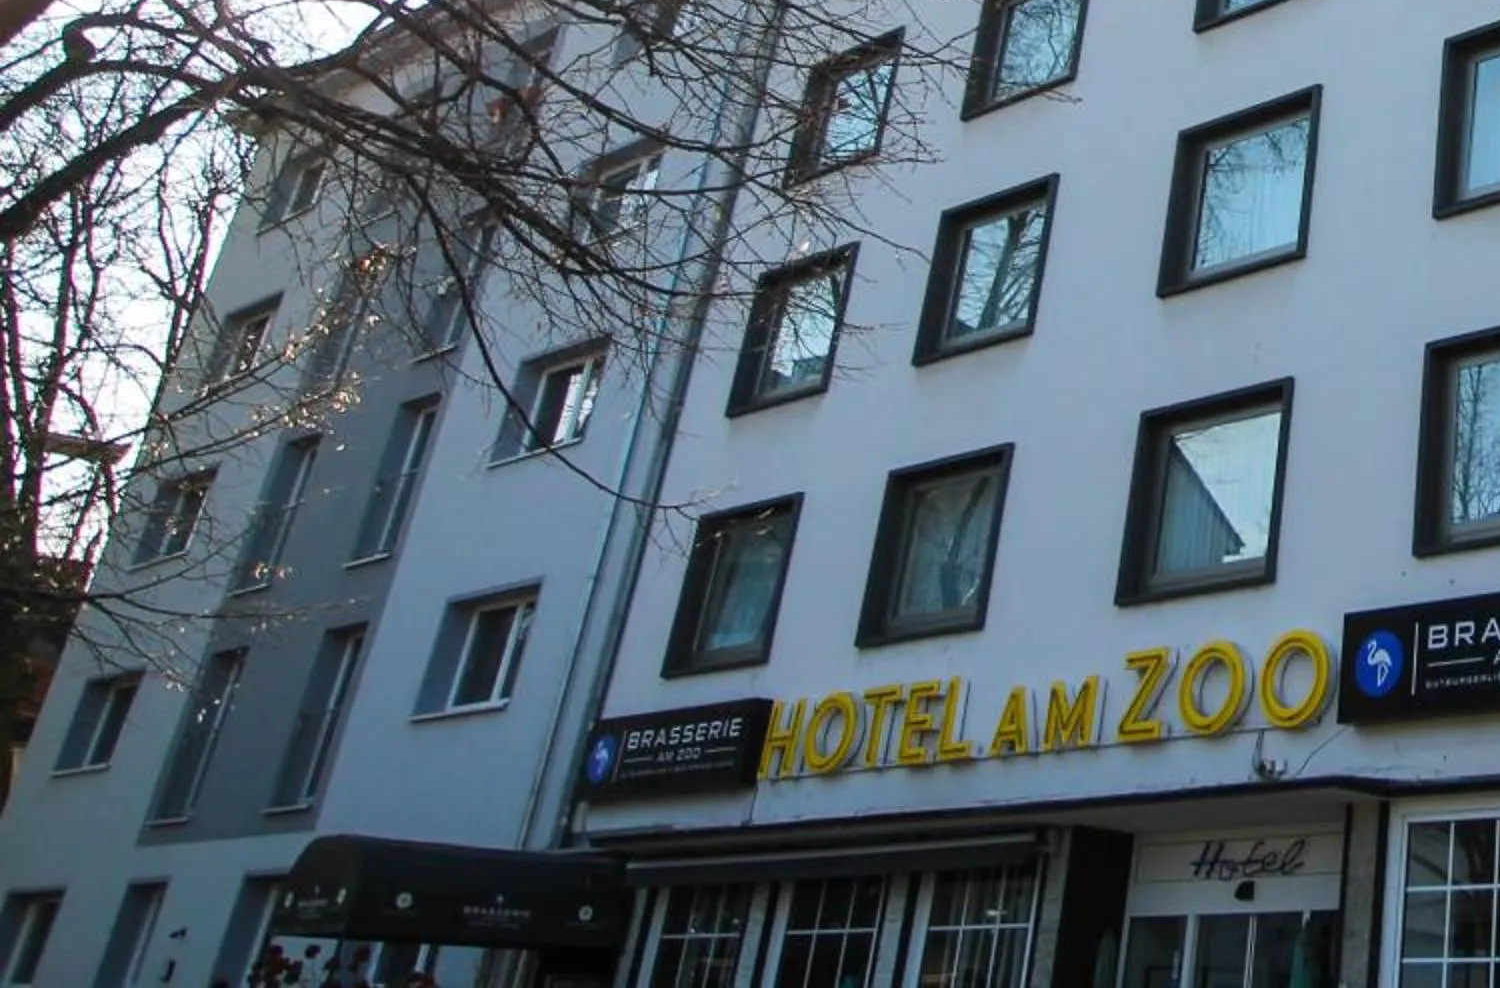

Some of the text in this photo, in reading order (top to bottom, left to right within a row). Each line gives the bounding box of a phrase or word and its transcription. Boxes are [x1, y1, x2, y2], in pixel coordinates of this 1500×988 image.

[757, 628, 1334, 780] HOTEL AM ZOO
[626, 716, 744, 750] BRASSERIE
[1190, 839, 1305, 881] Hotel
